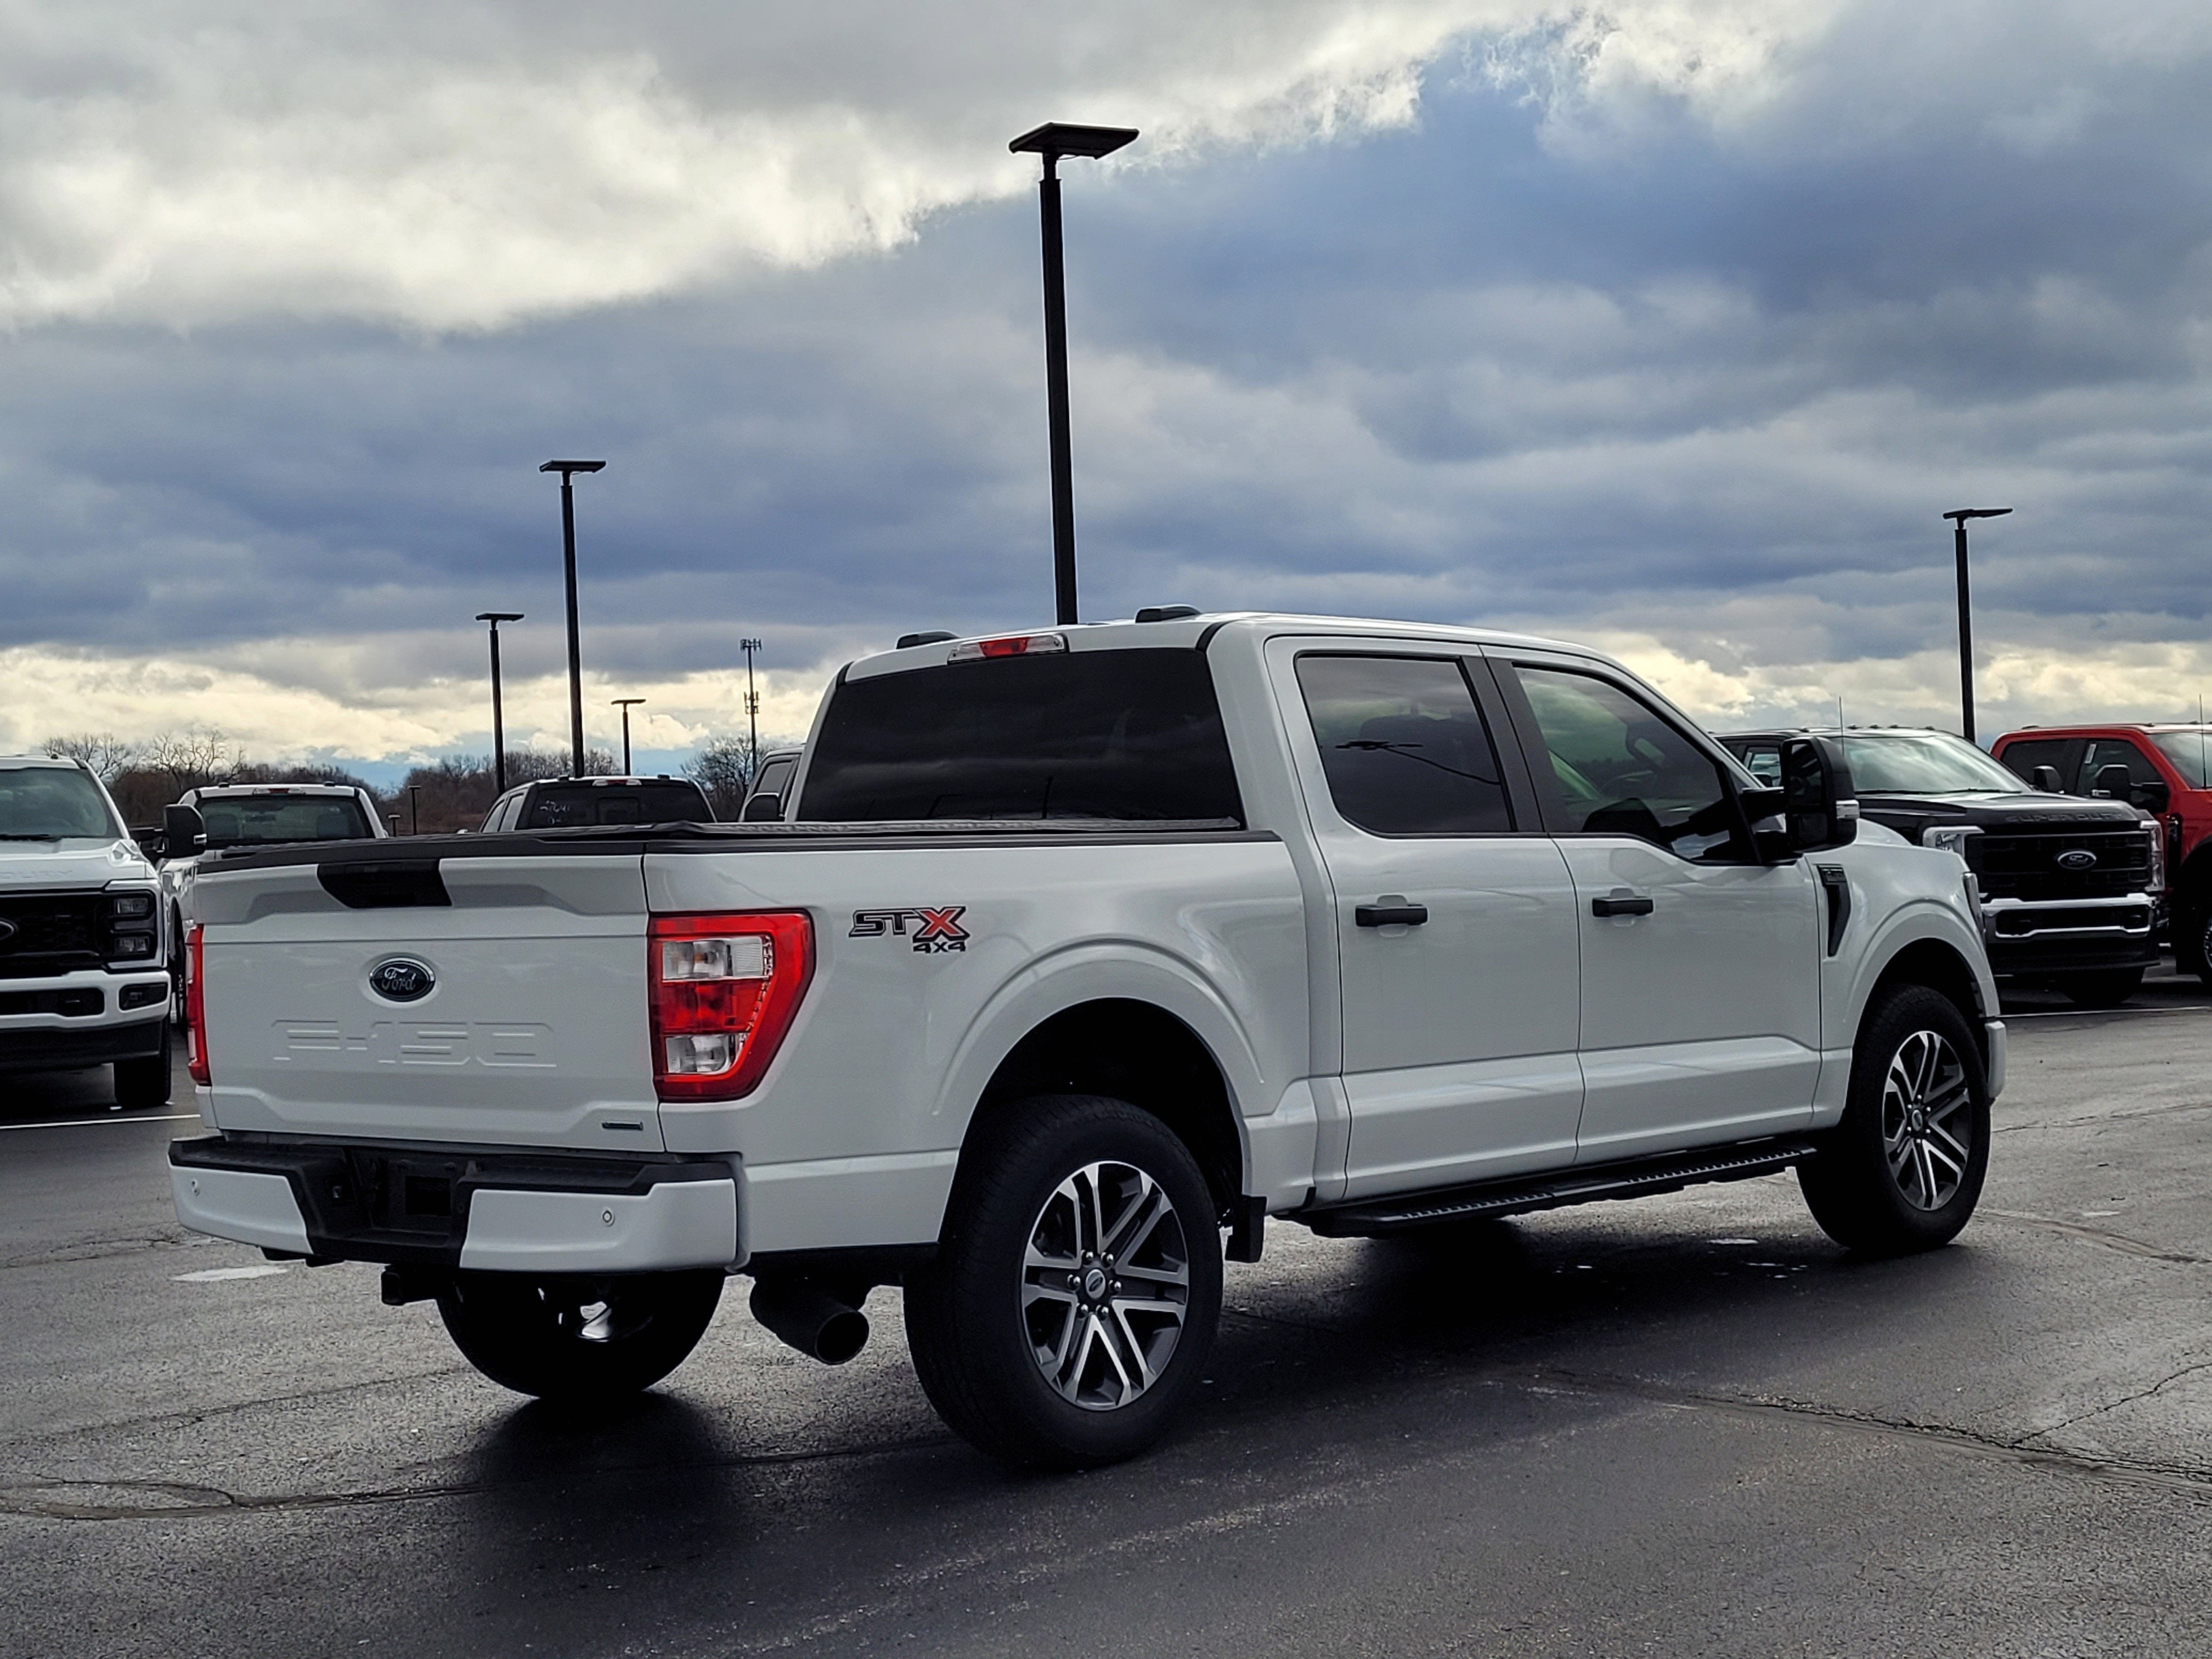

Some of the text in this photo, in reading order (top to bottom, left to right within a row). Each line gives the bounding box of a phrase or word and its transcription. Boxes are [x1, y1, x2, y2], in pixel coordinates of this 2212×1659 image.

[2005, 812, 2122, 822] SUPER DUTY
[848, 905, 970, 943] STX
[381, 967, 417, 991] Ford
[272, 1019, 558, 1067] F-150
